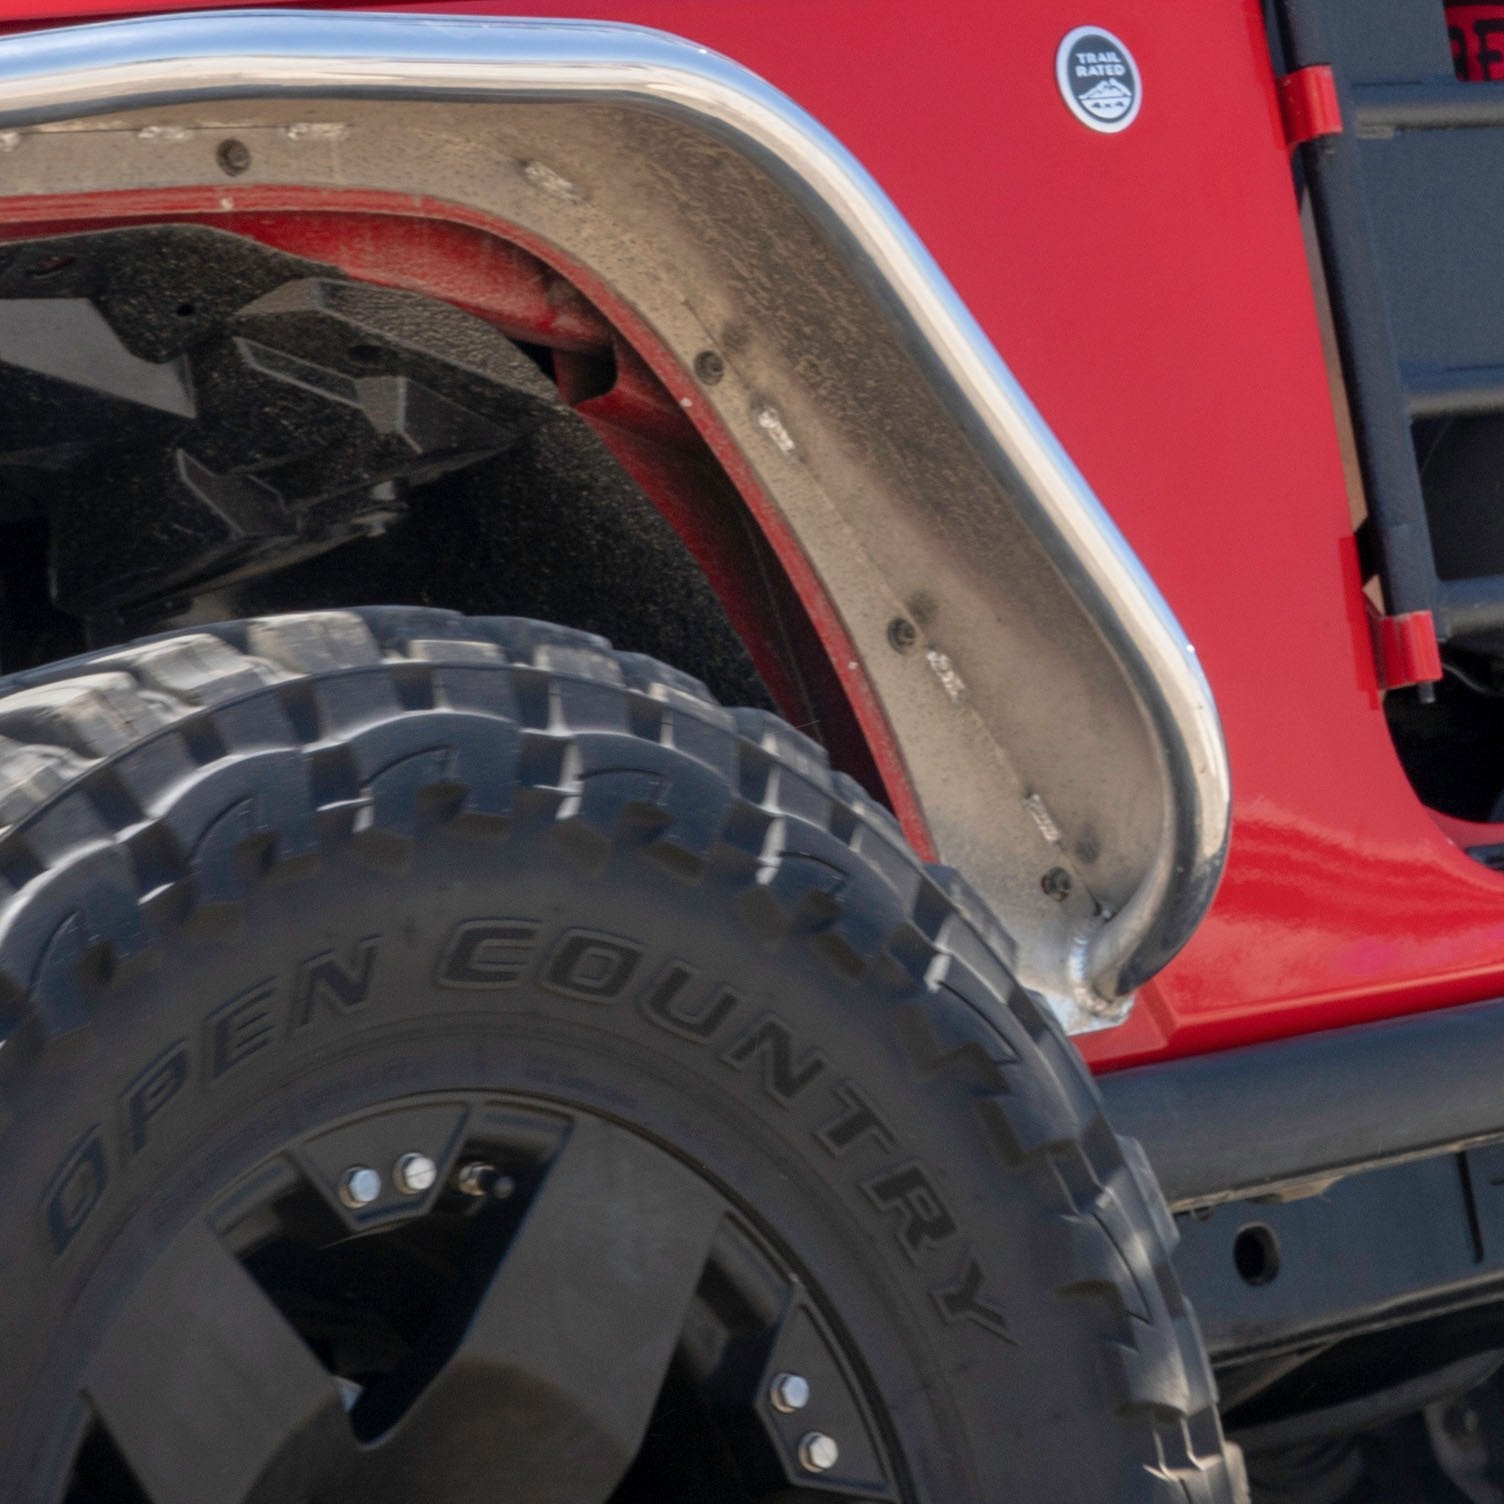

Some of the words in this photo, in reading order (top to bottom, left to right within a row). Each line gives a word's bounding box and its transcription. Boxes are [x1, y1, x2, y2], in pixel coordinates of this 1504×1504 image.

[1074, 51, 1122, 64] TRAIL
[1075, 63, 1126, 77] RATED
[40, 932, 384, 1261] OPEN
[432, 916, 1019, 1346] COUNTRY
